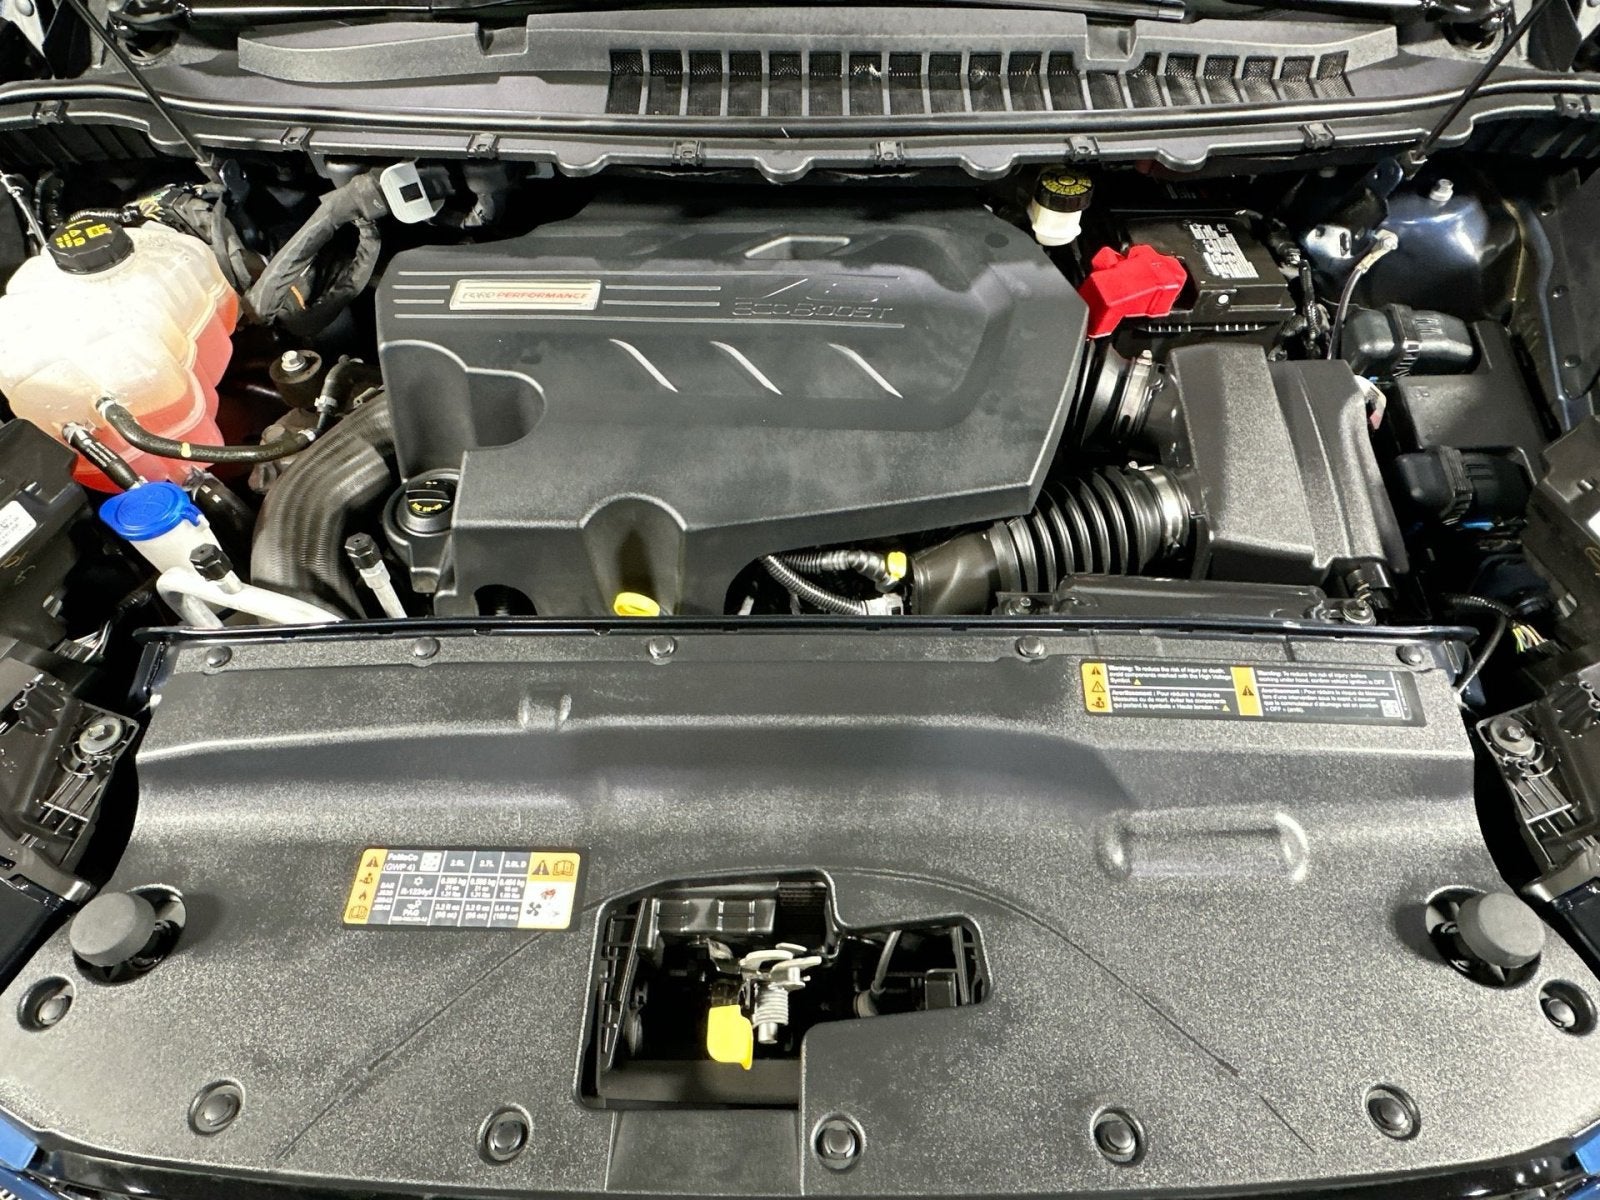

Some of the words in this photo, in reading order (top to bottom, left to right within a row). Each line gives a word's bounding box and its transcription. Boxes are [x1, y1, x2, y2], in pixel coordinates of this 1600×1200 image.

[496, 290, 589, 300] PERFORMANCE
[383, 863, 406, 871] (GWP
[400, 888, 433, 896] R-1234yf
